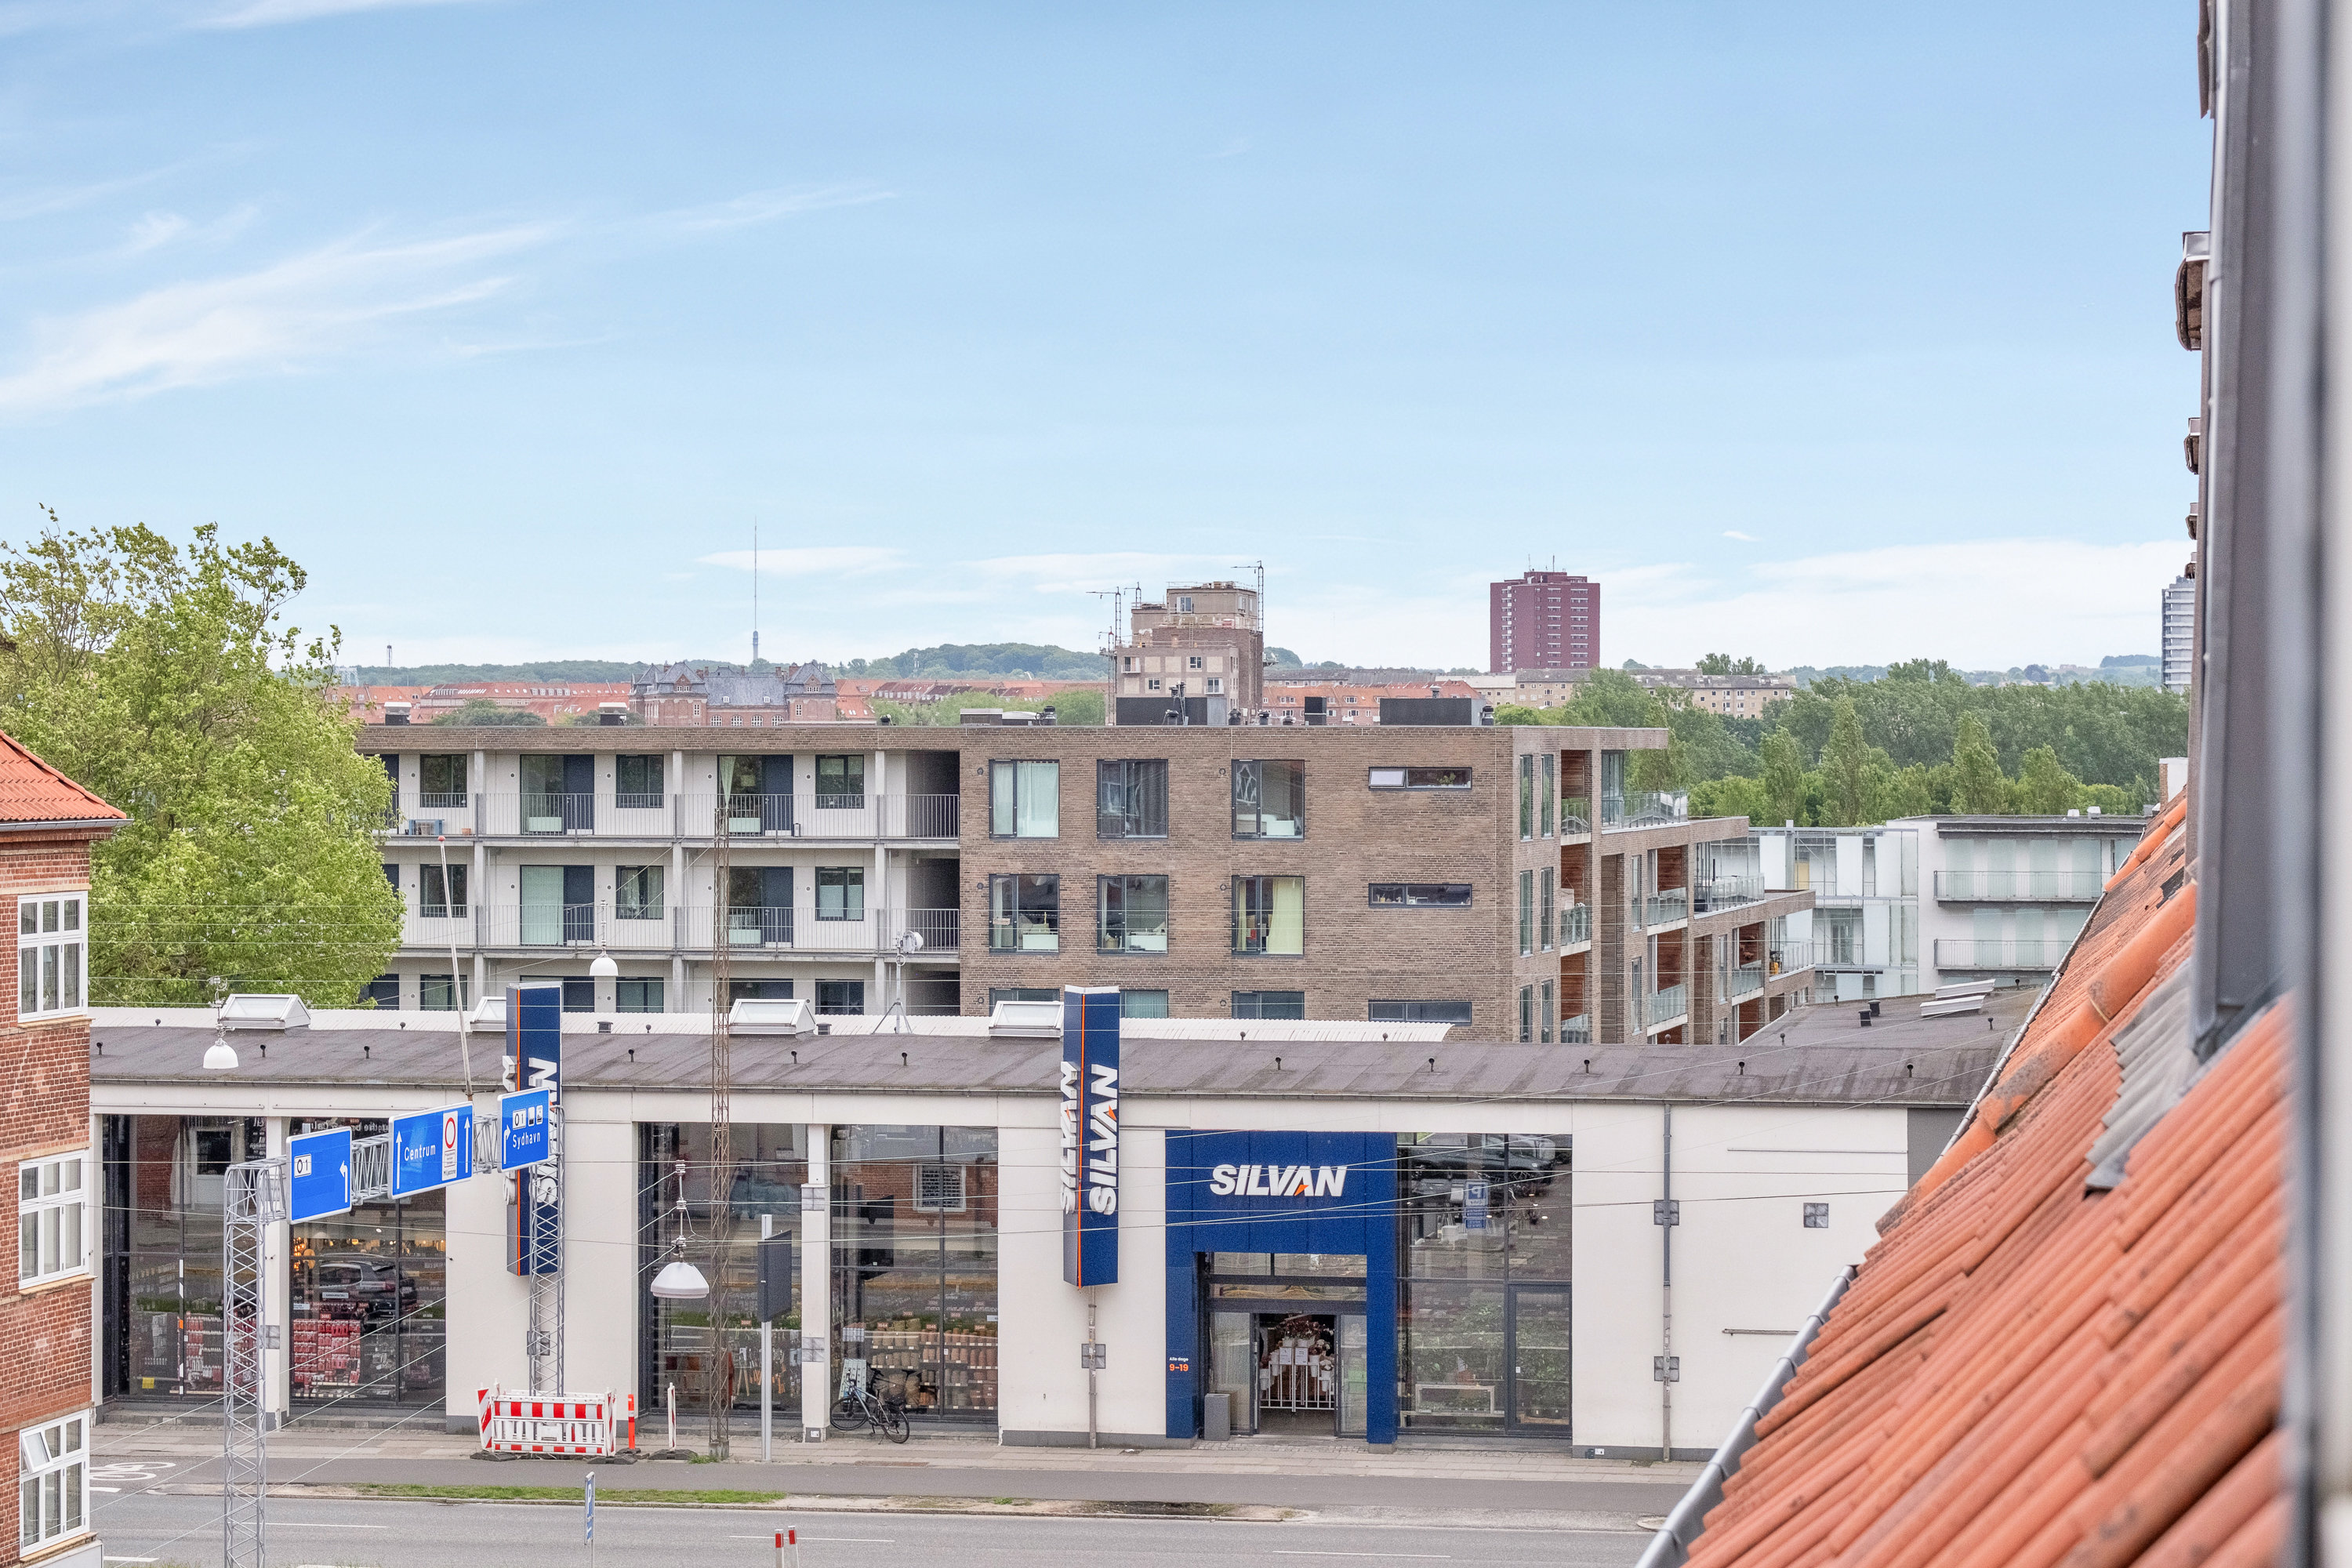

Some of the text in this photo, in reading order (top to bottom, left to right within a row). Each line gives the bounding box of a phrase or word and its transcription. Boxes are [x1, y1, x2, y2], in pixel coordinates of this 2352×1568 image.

[404, 1144, 436, 1161] Centrum
[512, 1131, 541, 1150] Sydhavn
[1060, 1061, 1077, 1214] SILVAN
[1089, 1063, 1118, 1215] SILVAN
[1210, 1163, 1348, 1197] SILVAN
